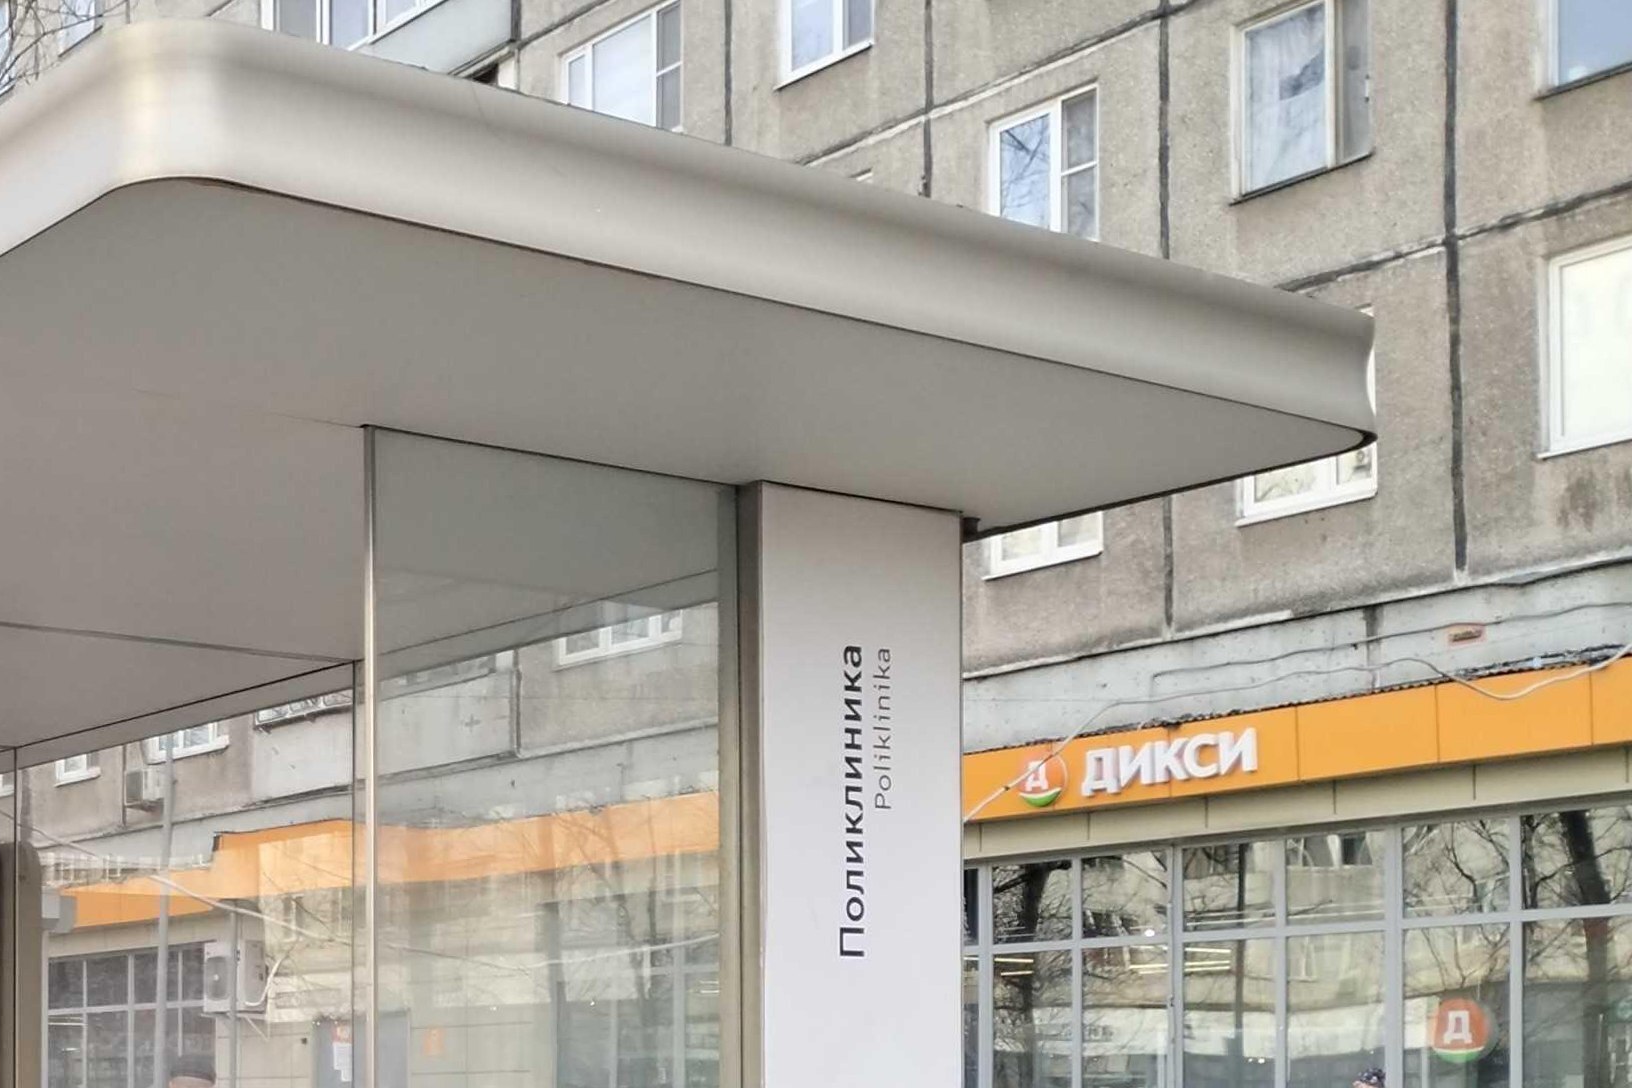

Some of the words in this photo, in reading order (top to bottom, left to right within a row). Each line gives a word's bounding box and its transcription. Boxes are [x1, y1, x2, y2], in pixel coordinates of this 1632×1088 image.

[873, 648, 892, 809] Poliklinika
[1081, 727, 1259, 797] ДИКСИ
[839, 644, 865, 957] Поликлиника
[1443, 1010, 1473, 1044] Д
